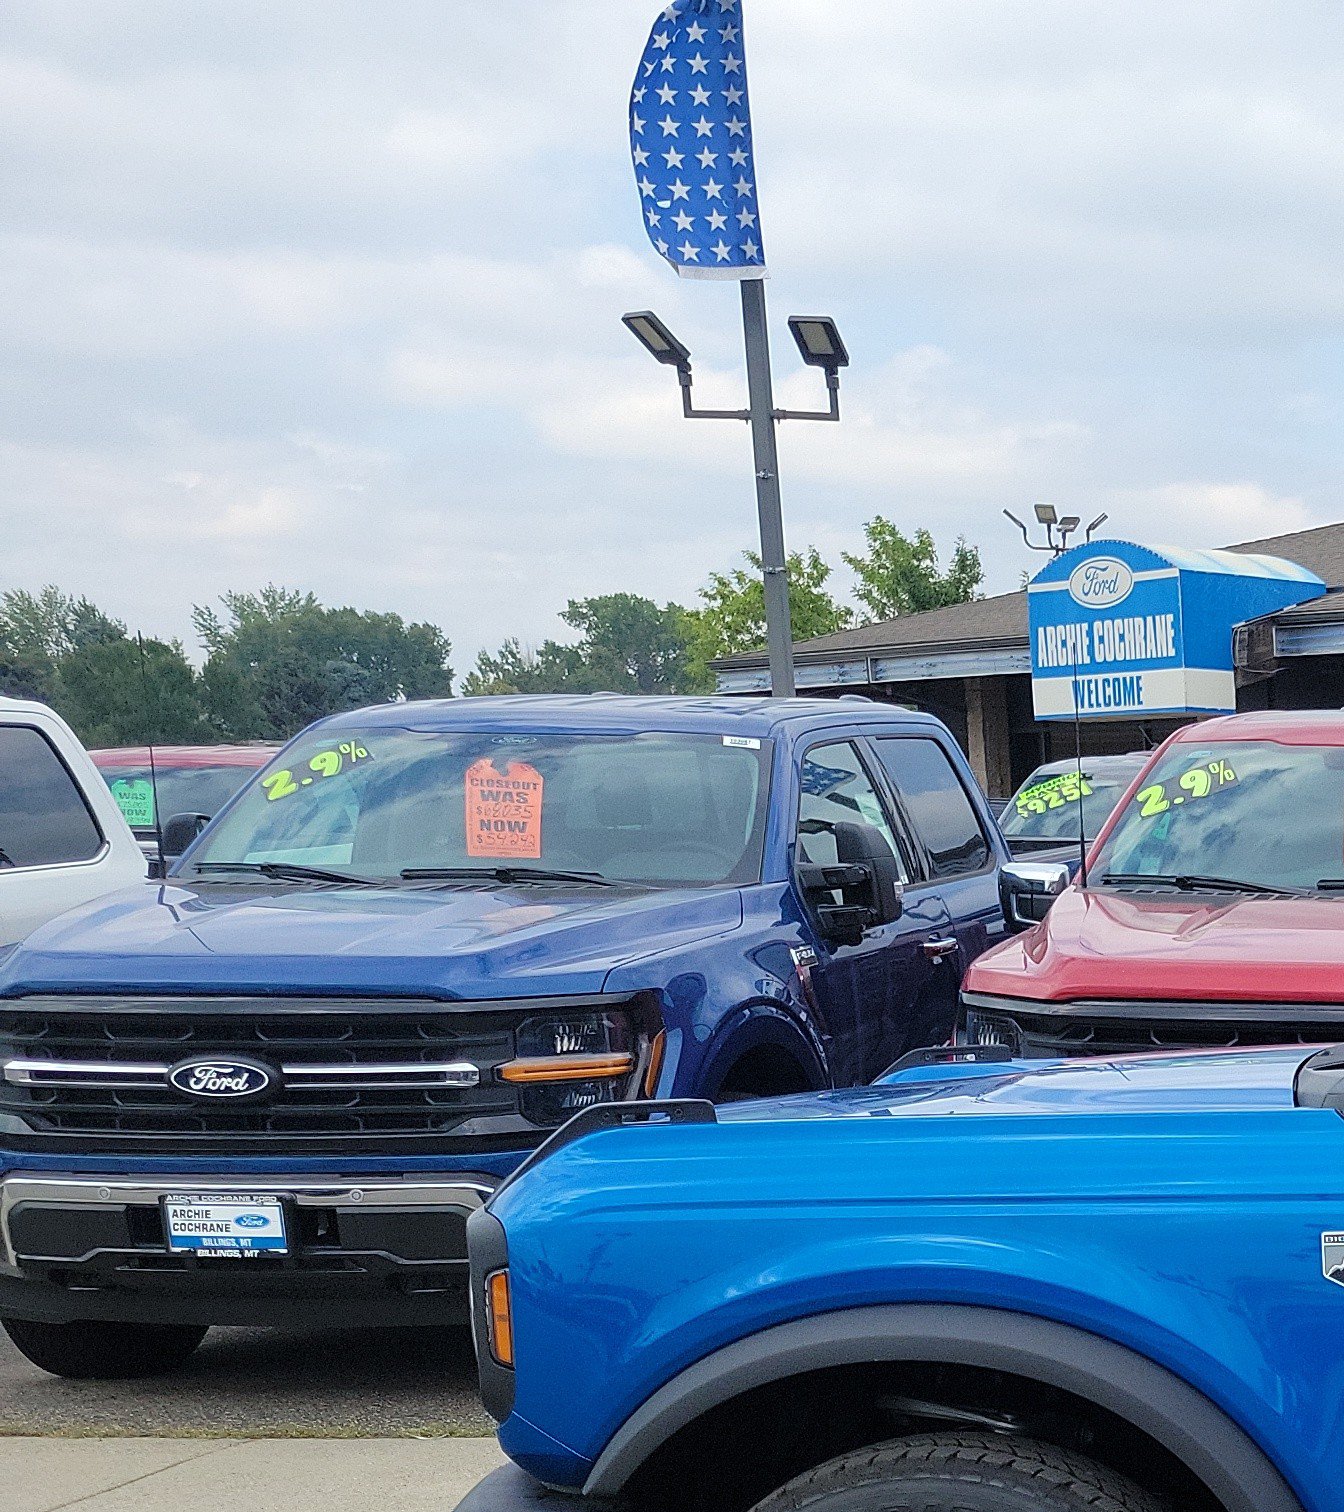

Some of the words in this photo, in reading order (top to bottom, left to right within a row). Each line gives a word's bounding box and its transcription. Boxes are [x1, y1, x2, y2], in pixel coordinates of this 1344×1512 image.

[1082, 565, 1119, 597] Ford
[1037, 623, 1091, 668] ARCHIE
[1093, 613, 1176, 663] COCHRANE
[1072, 675, 1143, 709] WELCOME
[262, 740, 368, 801] 2.9%
[470, 778, 540, 790] CLOSEOUT
[1136, 759, 1235, 817] 2.9%
[119, 792, 146, 801] WAS
[480, 789, 530, 804] WAS
[479, 819, 528, 833] NOW
[189, 1066, 250, 1091] Ford
[172, 1209, 211, 1219] ARCHIE
[241, 1215, 264, 1226] Ford
[172, 1222, 231, 1233] COCHRANE
[202, 1238, 239, 1248] BILLINGS,
[239, 1238, 252, 1247] MT
[197, 1249, 242, 1259] BILLINGS,
[244, 1249, 260, 1258] MT
